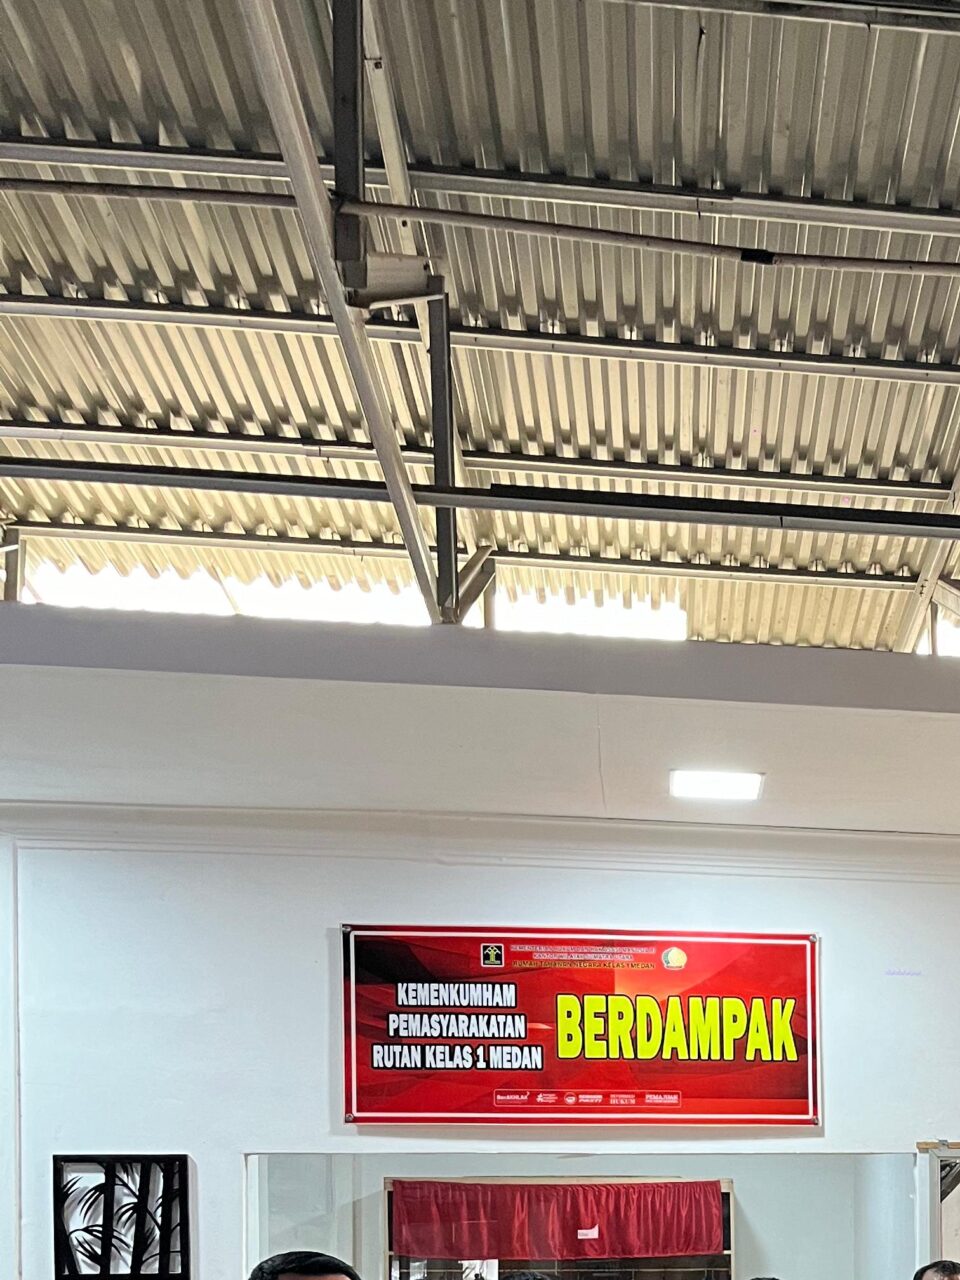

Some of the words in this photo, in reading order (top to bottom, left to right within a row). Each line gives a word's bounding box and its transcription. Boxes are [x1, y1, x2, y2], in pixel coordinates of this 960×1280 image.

[397, 982, 516, 1007] KEMENKUMHAM
[388, 1013, 526, 1038] PEMASYARAKATAN
[556, 994, 797, 1061] BERDAMPAK
[372, 1044, 422, 1068] RUTAN
[425, 1045, 473, 1069] KELAS
[476, 1045, 487, 1069] 1
[489, 1045, 542, 1069] MEDAN
